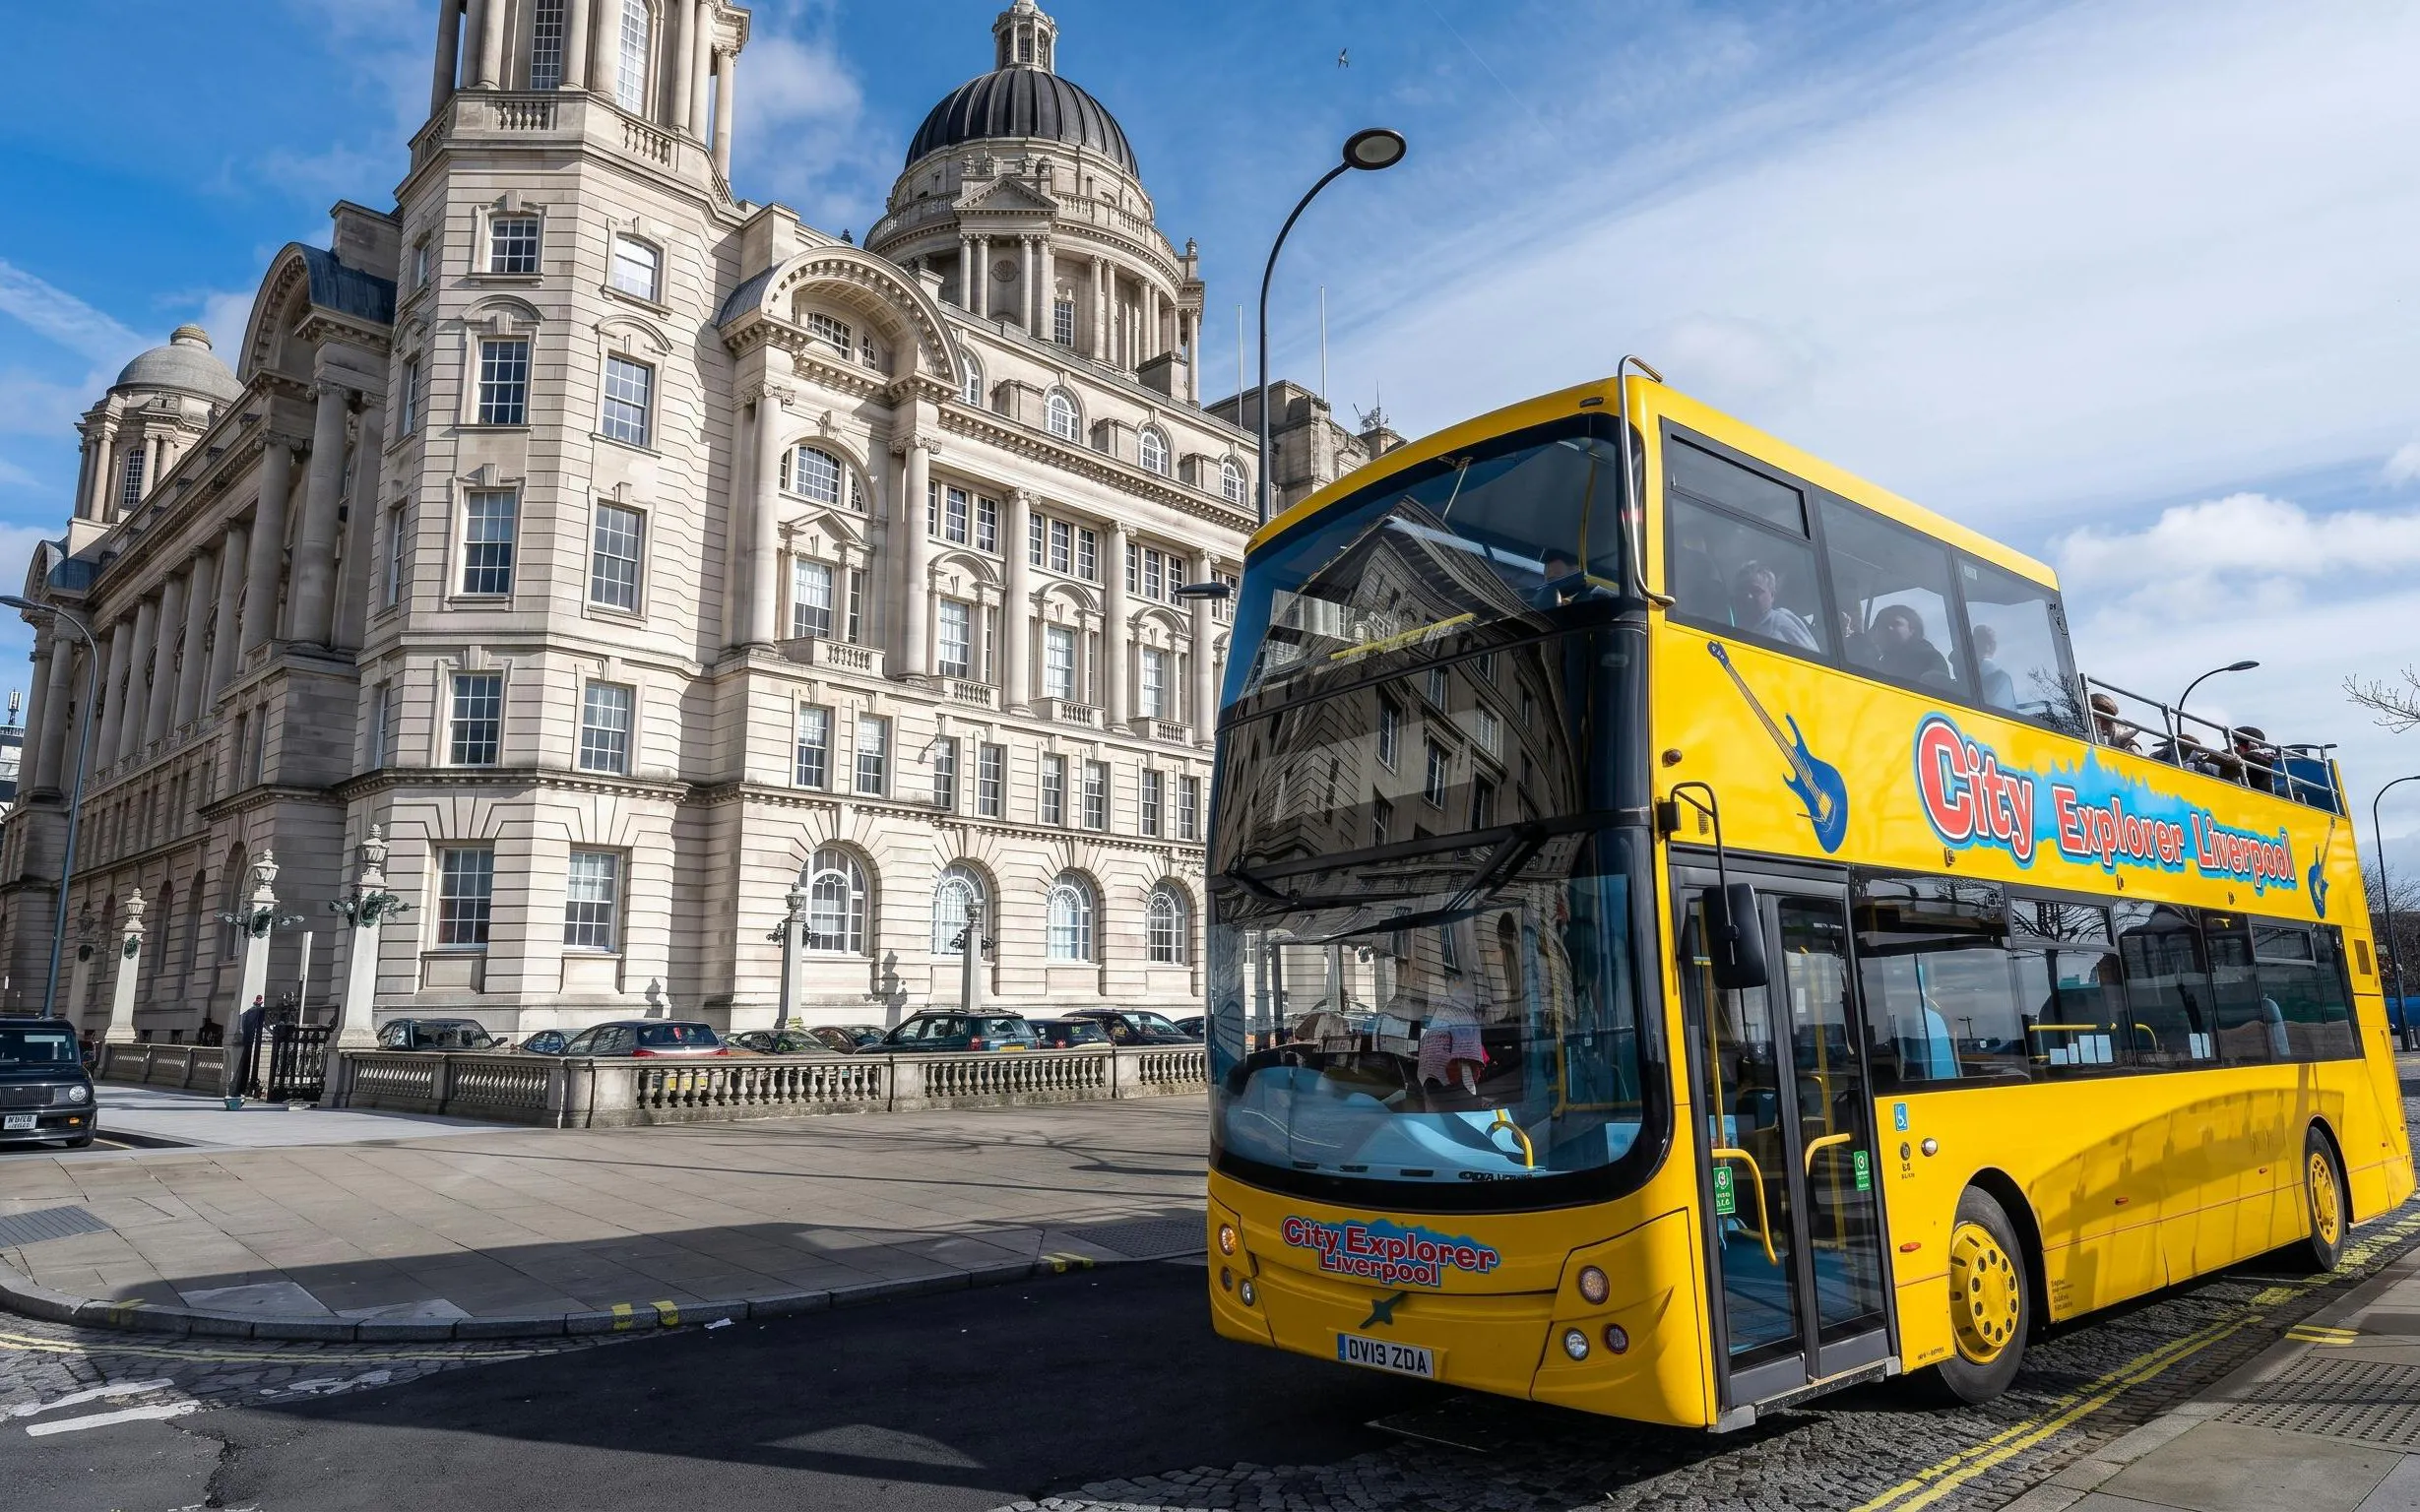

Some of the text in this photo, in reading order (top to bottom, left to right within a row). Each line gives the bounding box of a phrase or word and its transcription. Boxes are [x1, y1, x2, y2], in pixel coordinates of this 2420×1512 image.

[1918, 721, 2295, 888] City Explorer Liverpool
[1282, 1217, 1497, 1272] City Explorer
[1319, 1248, 1439, 1286] Liverpool
[1391, 1346, 1428, 1374] ZDA
